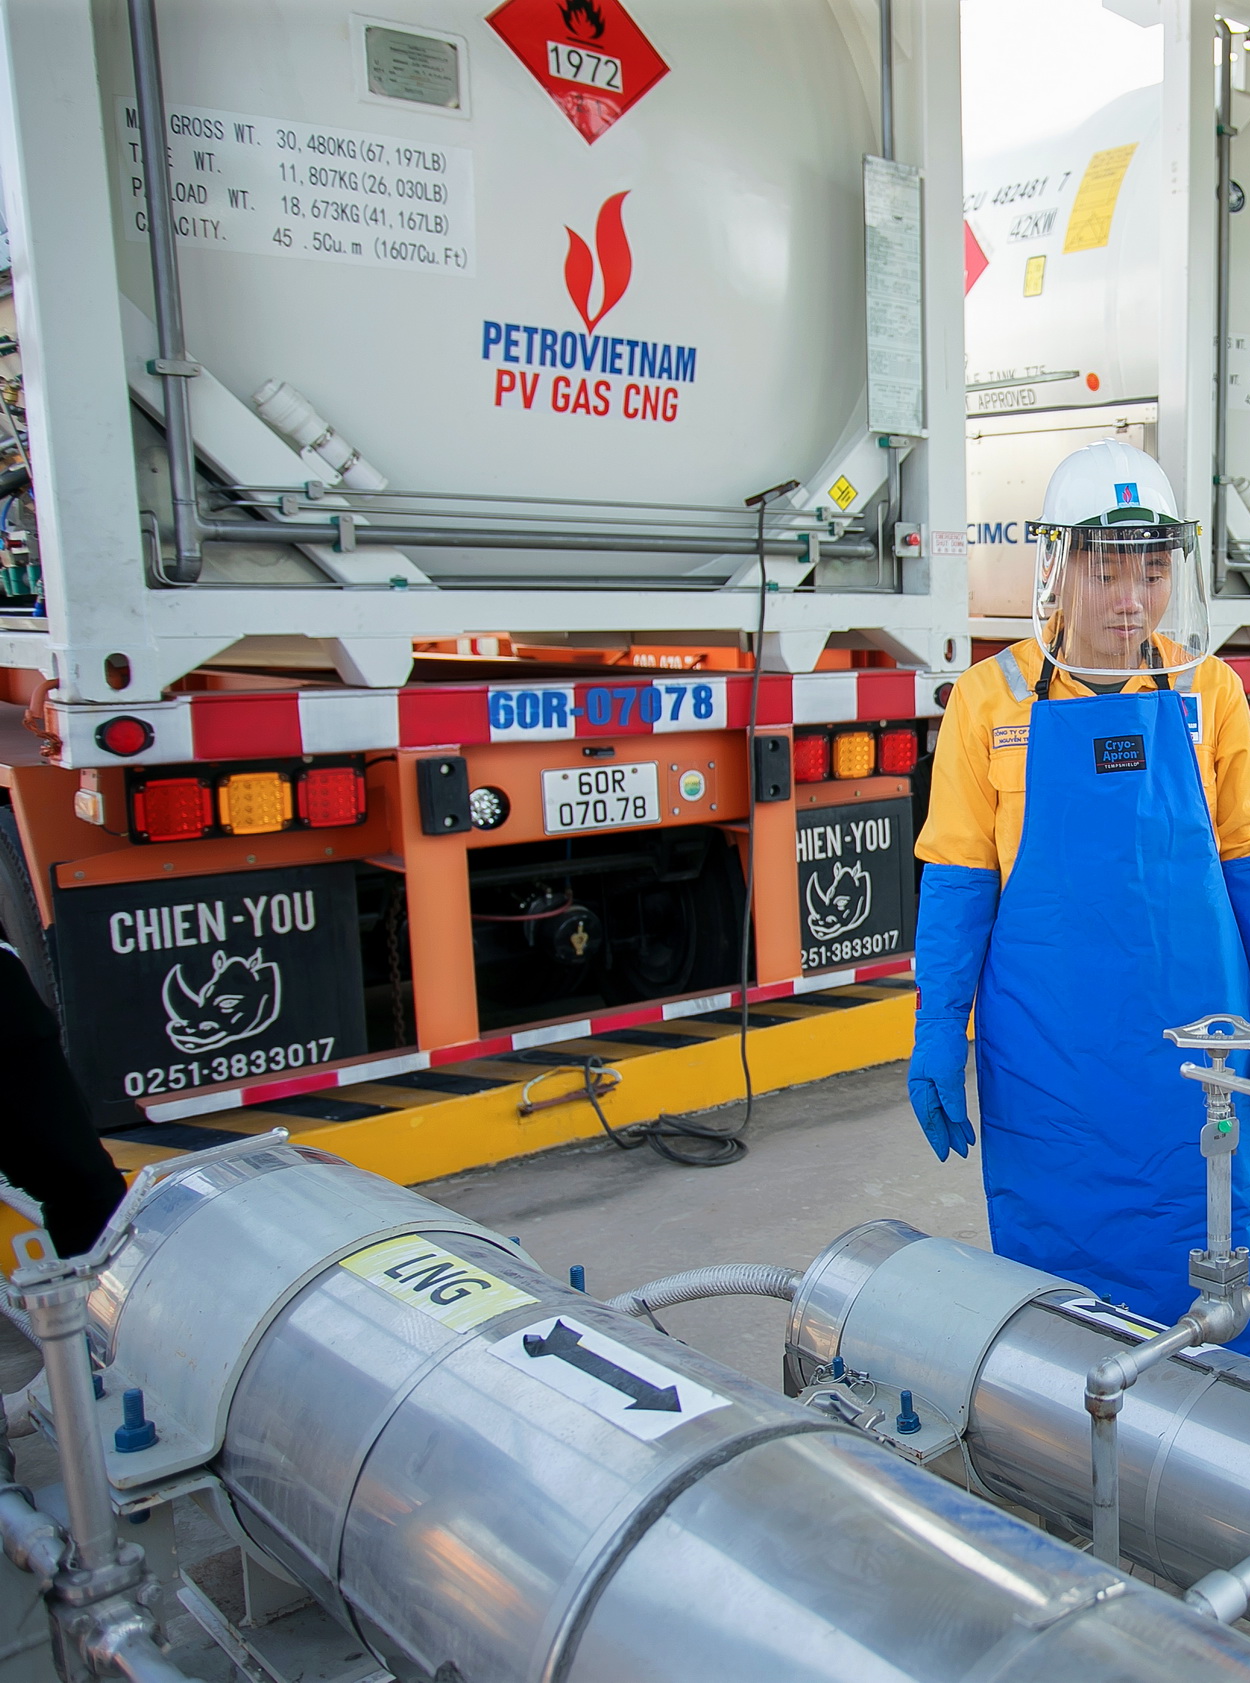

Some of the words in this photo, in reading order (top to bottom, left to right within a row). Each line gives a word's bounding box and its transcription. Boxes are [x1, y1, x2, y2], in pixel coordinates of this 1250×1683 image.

[550, 45, 620, 89] 1972
[170, 114, 224, 140] GROSS
[234, 122, 262, 146] WT.
[129, 142, 174, 168] TE
[194, 150, 222, 174] WT.
[132, 177, 207, 204] POAD
[228, 188, 256, 211] WT.
[992, 177, 1049, 205] 482481
[135, 212, 228, 240] CCITY.
[1010, 210, 1058, 239] 42KW
[482, 320, 697, 383] PETROVIETNAM
[494, 368, 540, 410] PV
[551, 375, 612, 417] GAS
[623, 383, 678, 423] CNG
[978, 389, 1036, 410] APPROVED
[967, 522, 1018, 545] CIMC
[489, 684, 714, 730] 60R-07078
[1103, 751, 1137, 762] Apron
[1105, 740, 1135, 751] Cryo-
[578, 769, 625, 796] 60R
[559, 796, 647, 827] 070.78
[796, 817, 891, 863] HIEN-YOU
[801, 930, 899, 970] 251-3833017
[383, 1253, 492, 1306] LNG
